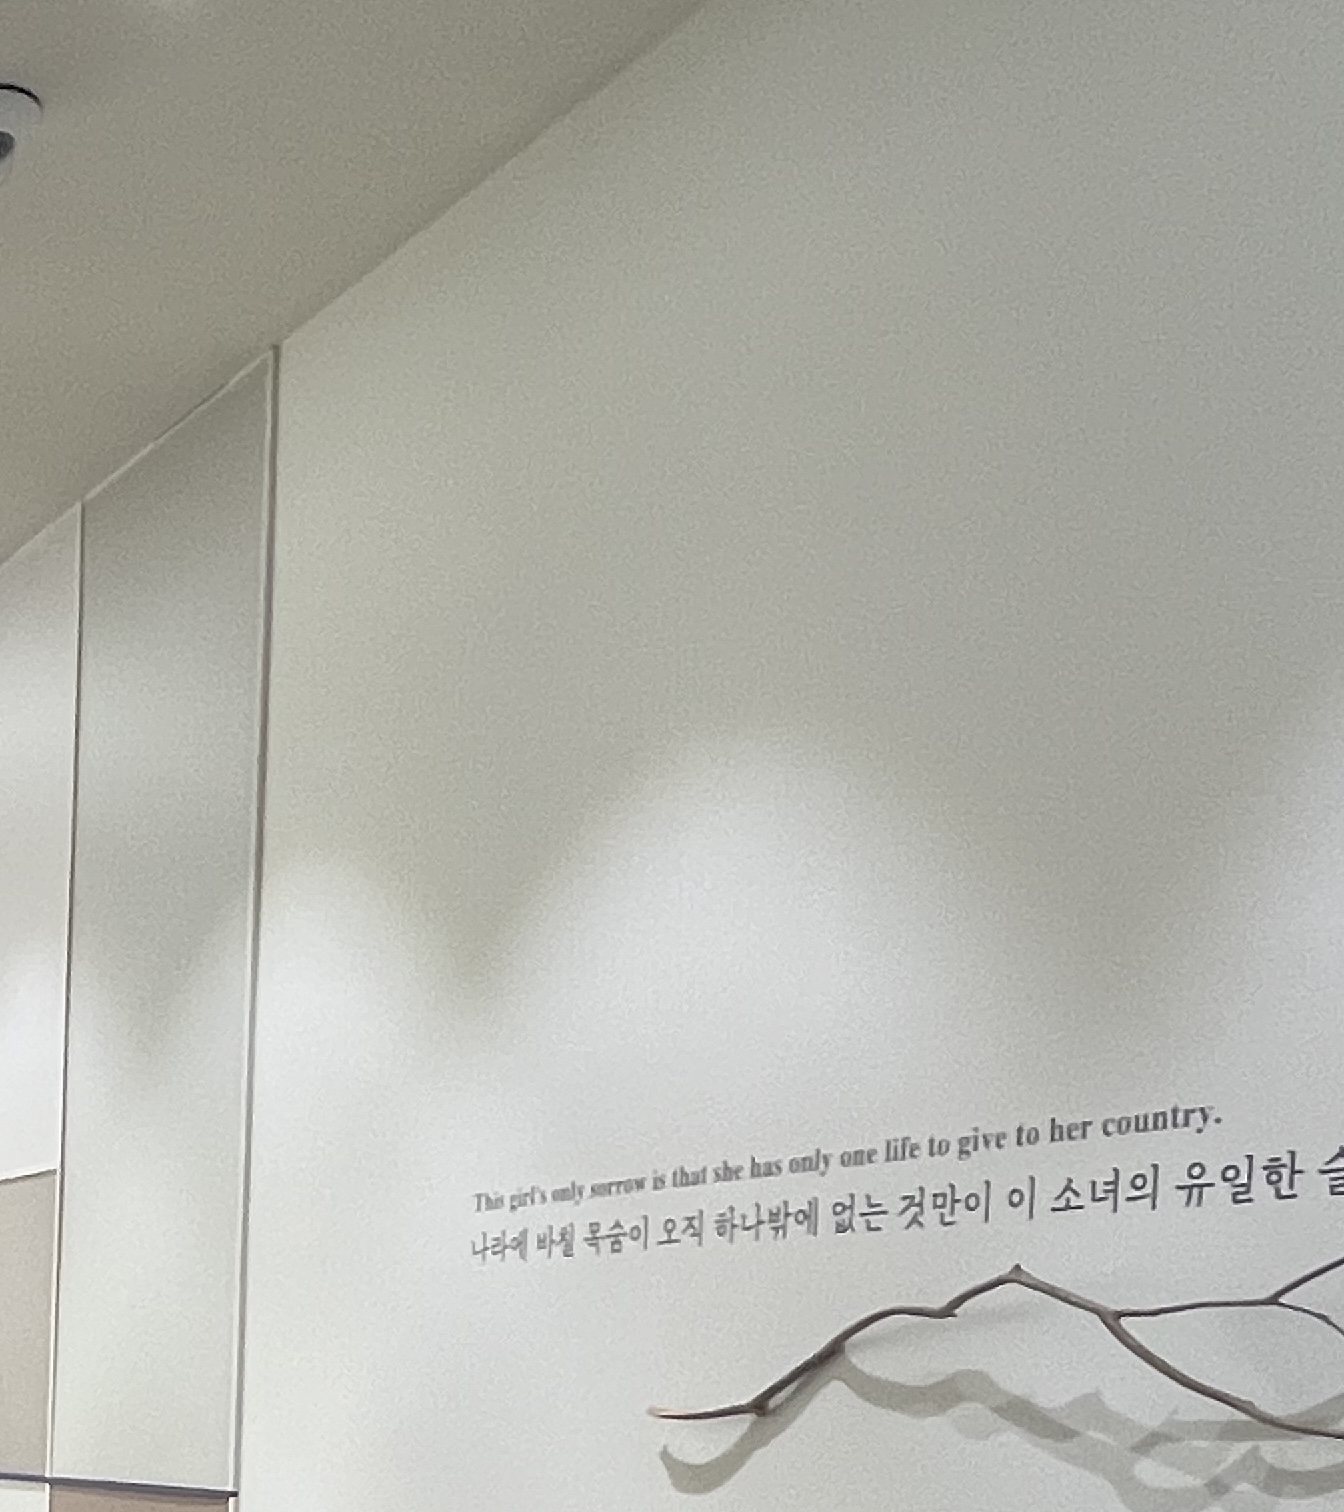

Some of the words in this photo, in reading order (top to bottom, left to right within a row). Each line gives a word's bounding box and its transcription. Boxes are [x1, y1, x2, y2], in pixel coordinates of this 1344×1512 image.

[470, 1227, 528, 1262] 나라에
[583, 1214, 648, 1255] 목숨이
[656, 1209, 704, 1247] 오직
[714, 1197, 819, 1243] 하나밖에
[832, 1193, 889, 1235] 없는
[897, 1180, 992, 1231] 것만이
[1008, 1175, 1036, 1220] 이
[1050, 1163, 1160, 1214] 소녀의
[1175, 1150, 1305, 1208] 유일한
[476, 1191, 504, 1212] This
[552, 1181, 584, 1205] only
[590, 1175, 647, 1197] sorrow
[653, 1170, 666, 1190] is
[672, 1165, 708, 1187] that
[713, 1160, 743, 1182] she
[750, 1155, 783, 1178] has
[788, 1148, 831, 1177] only
[840, 1147, 878, 1168] one
[884, 1136, 921, 1162] life
[928, 1135, 950, 1158] to
[958, 1127, 1007, 1161] give
[1016, 1124, 1040, 1147] to
[1050, 1117, 1093, 1143] her
[1101, 1103, 1222, 1136] country.
